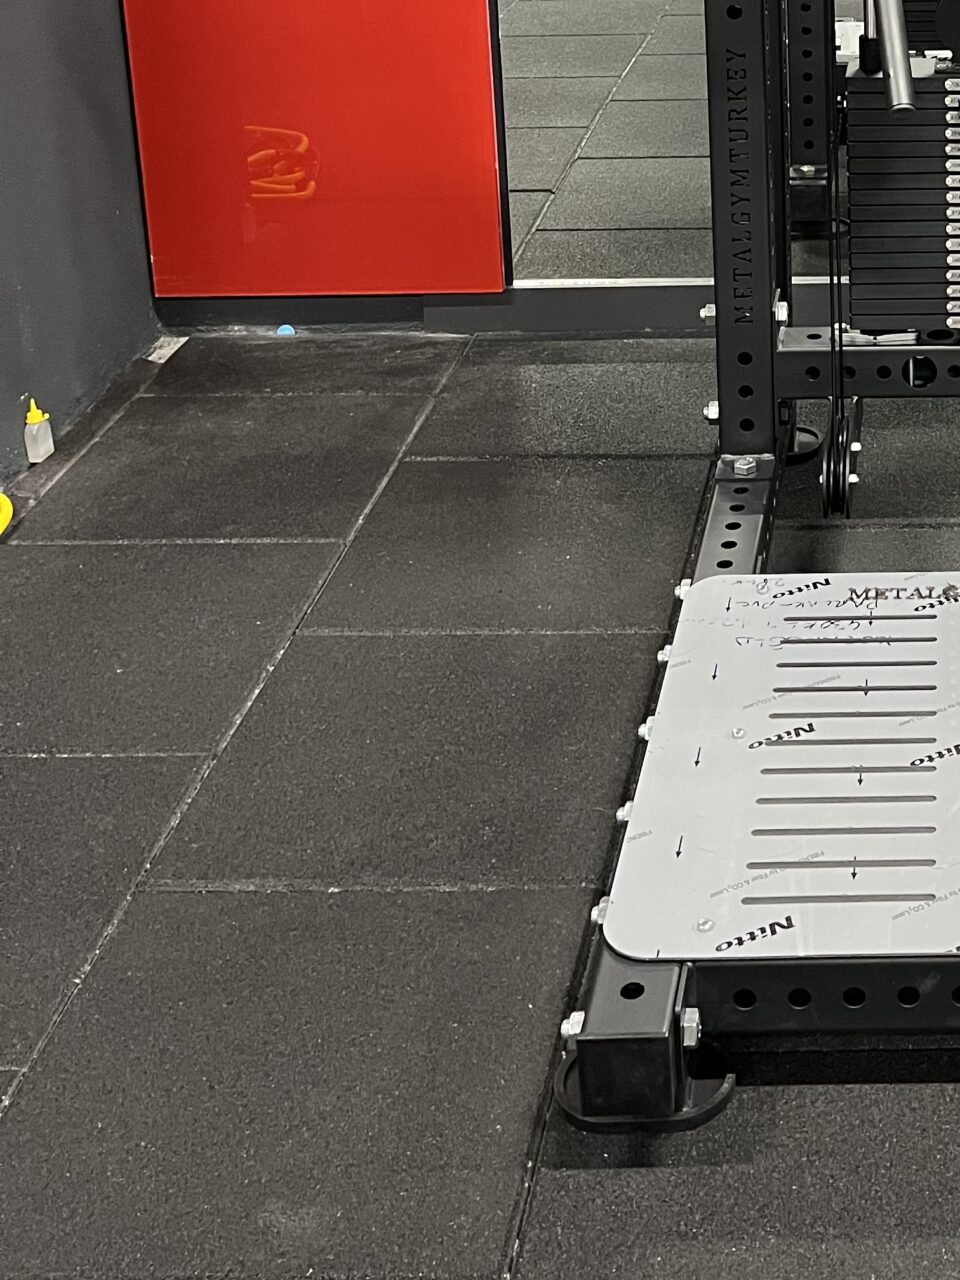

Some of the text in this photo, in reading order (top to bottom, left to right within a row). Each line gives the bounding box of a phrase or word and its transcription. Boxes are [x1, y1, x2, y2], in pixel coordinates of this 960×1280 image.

[726, 48, 754, 324] METALGYMTURKEY
[772, 578, 831, 599] Nitto
[748, 722, 816, 749] Nitto
[715, 914, 796, 952] Nitto
